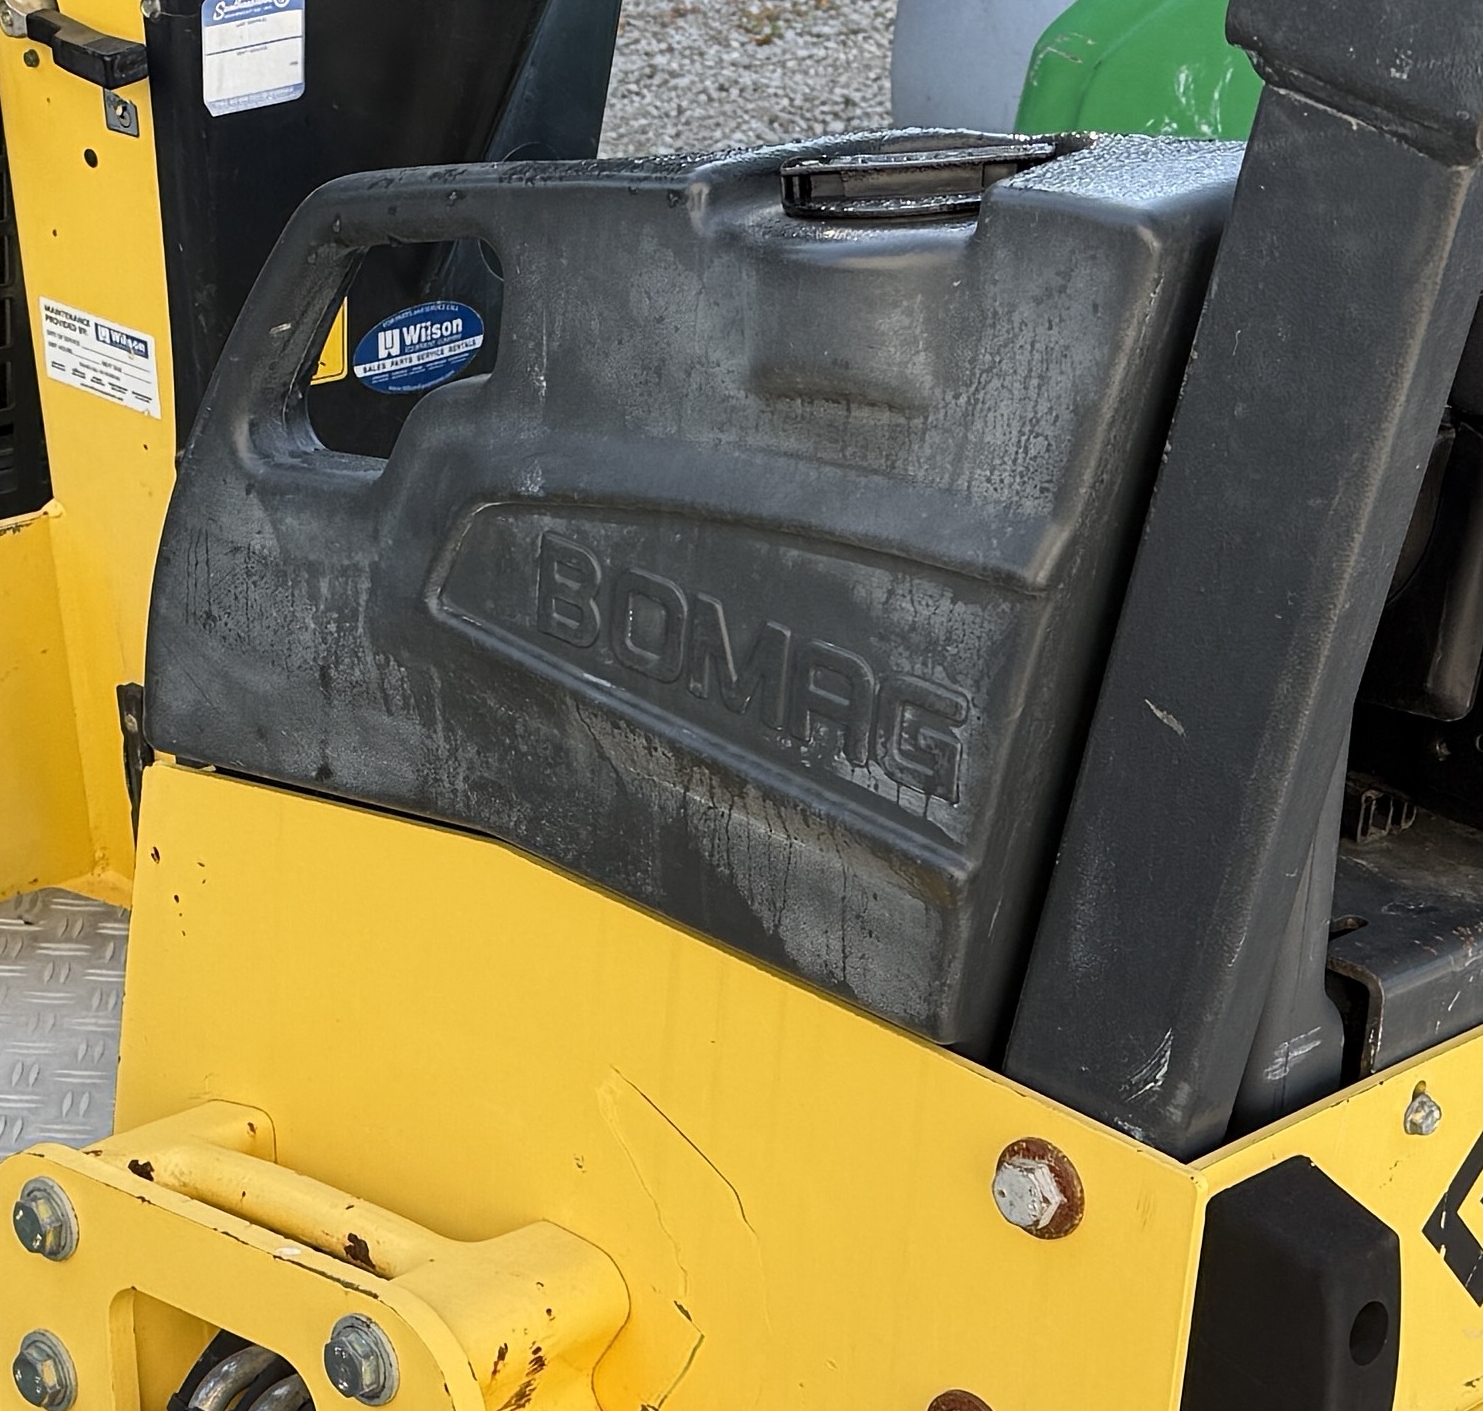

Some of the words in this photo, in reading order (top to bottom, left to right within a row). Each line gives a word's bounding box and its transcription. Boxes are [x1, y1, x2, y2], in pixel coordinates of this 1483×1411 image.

[402, 318, 463, 346] Wilson
[390, 356, 413, 368] PARTS
[417, 348, 445, 362] SERVICE
[536, 530, 974, 807] BOMAG
